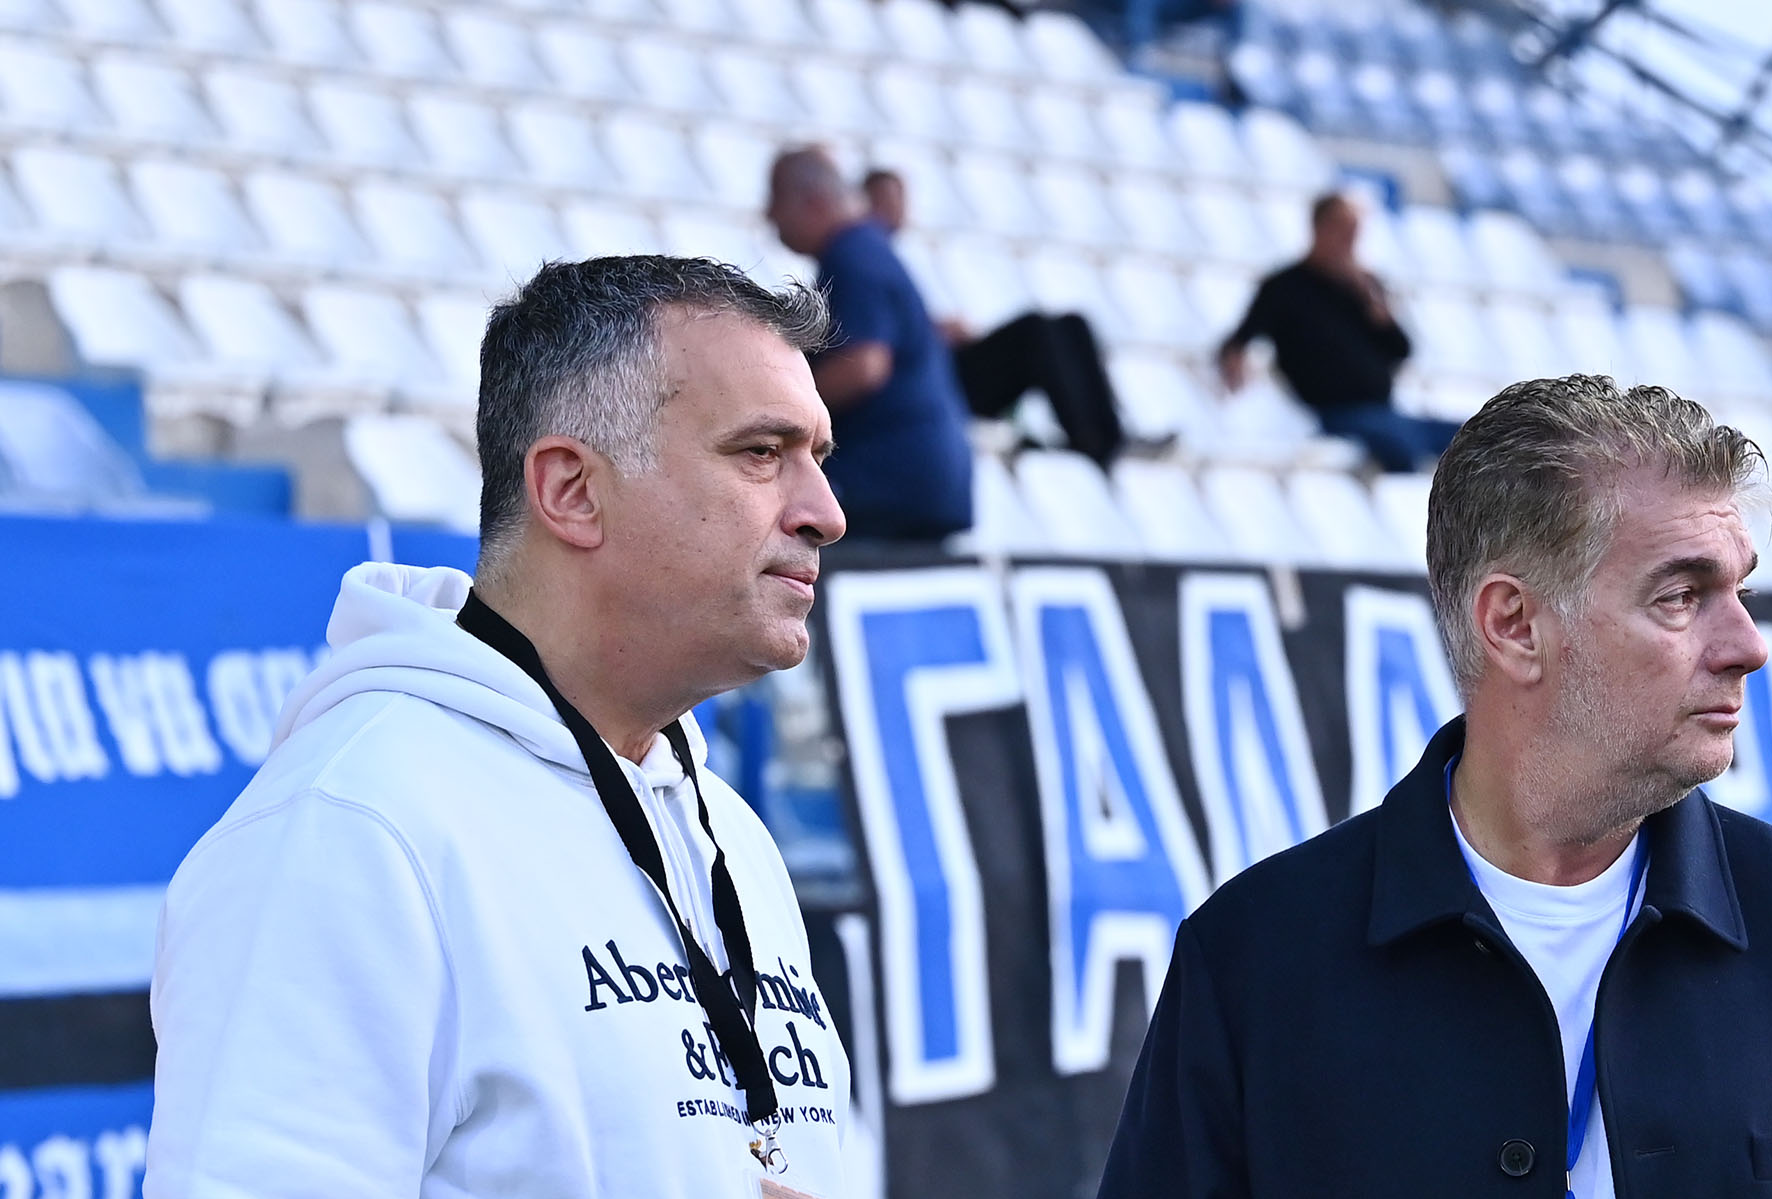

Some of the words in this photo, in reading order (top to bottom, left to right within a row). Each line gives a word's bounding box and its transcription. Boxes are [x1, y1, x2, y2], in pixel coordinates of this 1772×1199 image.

[681, 1028, 716, 1081] &
[703, 1020, 829, 1089] Fch
[799, 1106, 836, 1125] YORK
